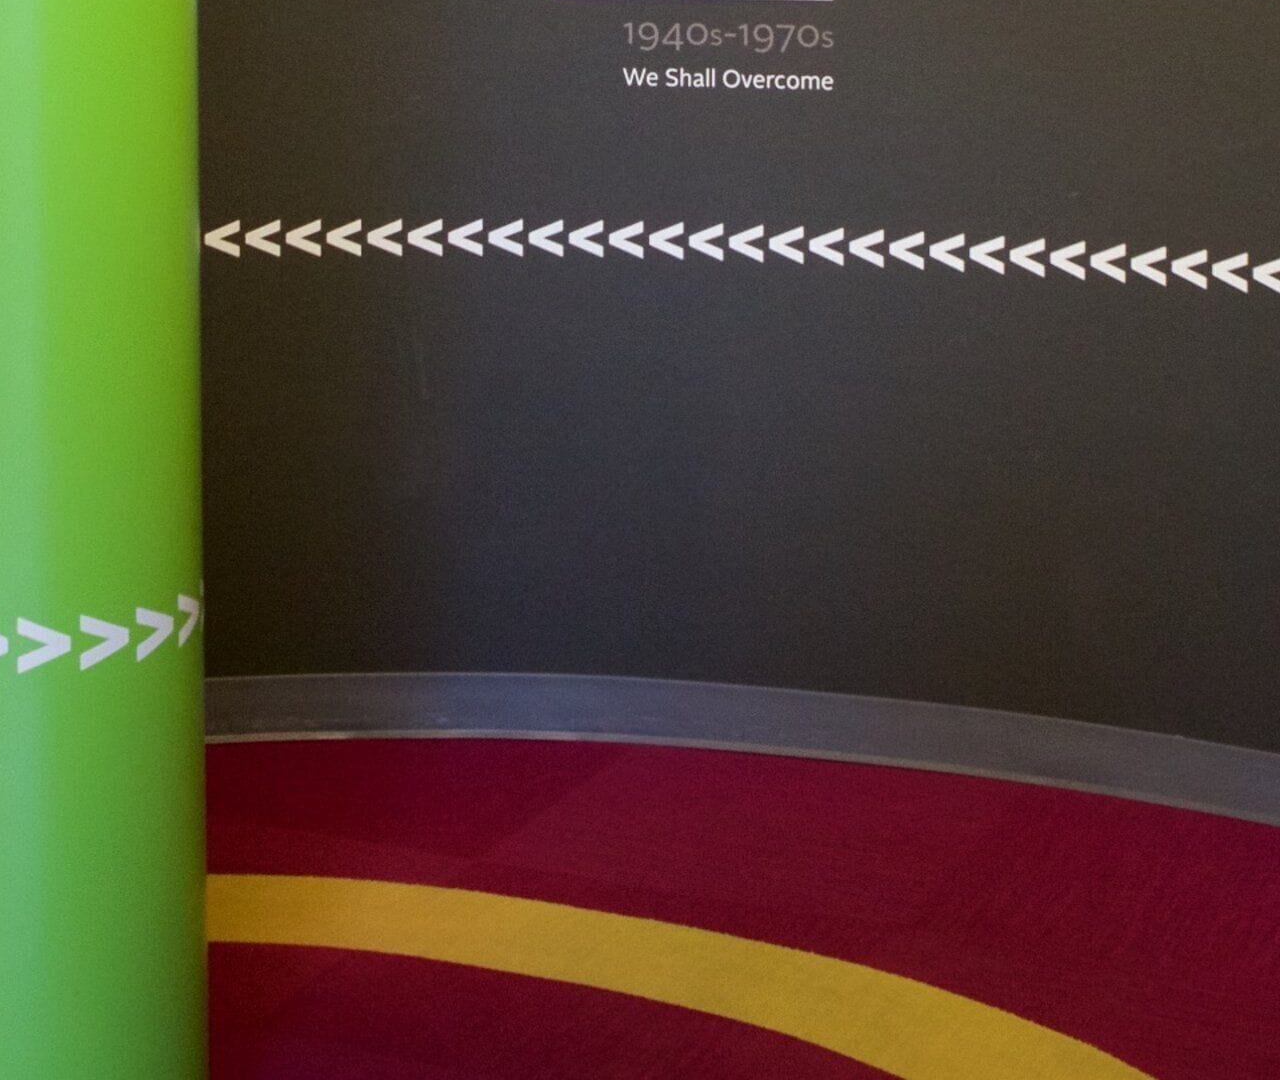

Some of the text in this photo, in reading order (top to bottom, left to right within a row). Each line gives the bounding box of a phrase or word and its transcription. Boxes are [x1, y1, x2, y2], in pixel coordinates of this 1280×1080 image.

[624, 22, 834, 53] 1940s-1970s
[623, 68, 834, 91] We Shall Overcome
